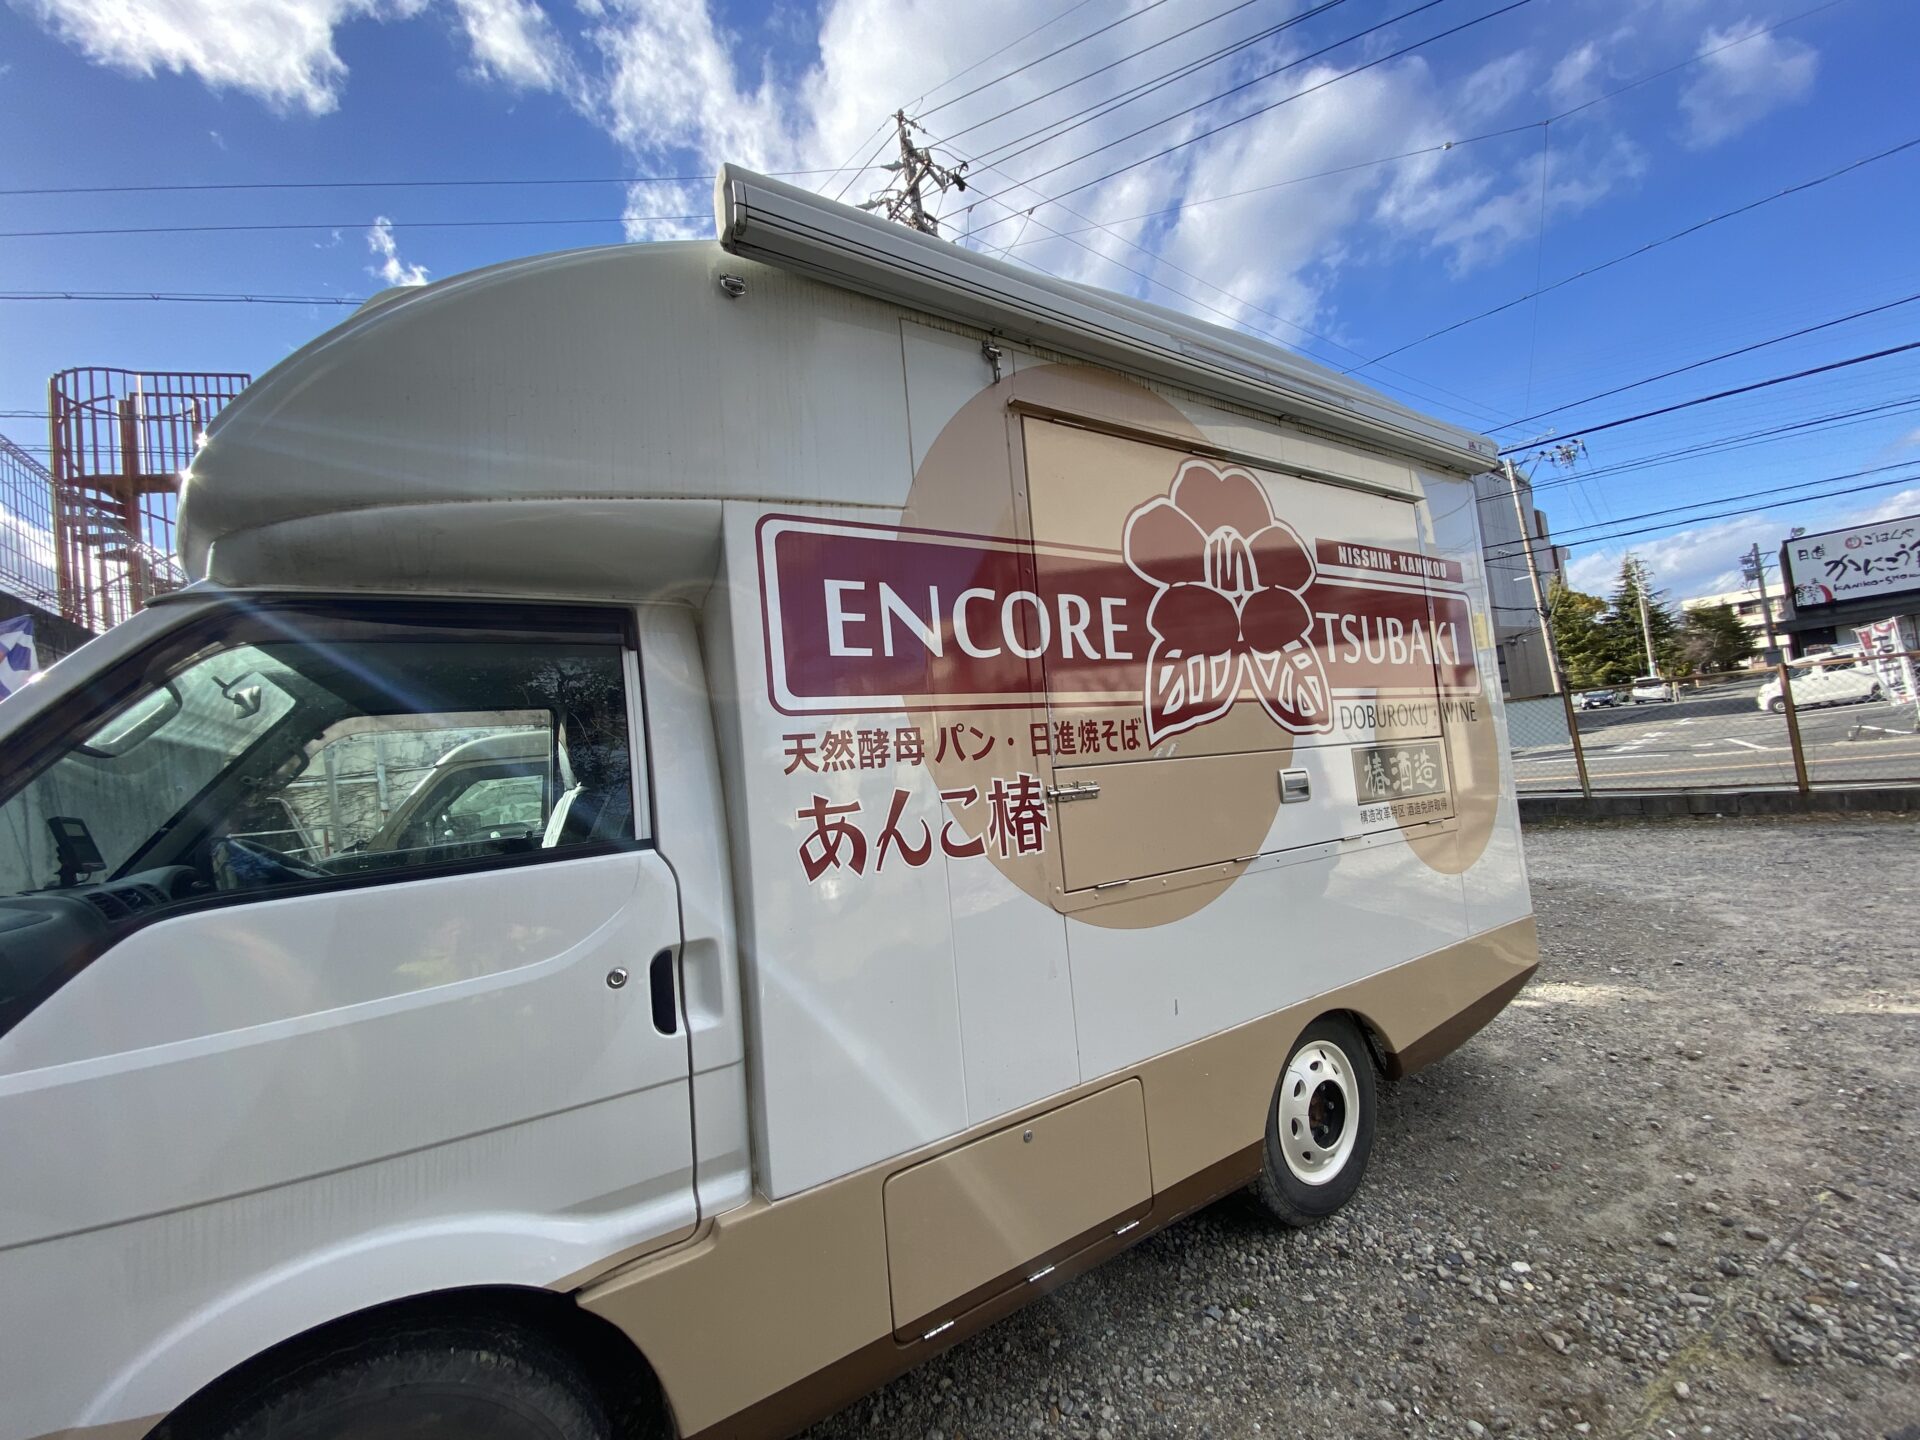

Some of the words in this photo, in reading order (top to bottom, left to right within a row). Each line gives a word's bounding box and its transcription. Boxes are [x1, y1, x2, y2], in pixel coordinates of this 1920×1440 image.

[824, 579, 1133, 659] ENCORE
[1316, 612, 1460, 665] TSUBAKI
[1340, 702, 1428, 730] DOBUROKU
[1441, 701, 1477, 723] WINE
[782, 727, 926, 776] 天然酵母
[1364, 748, 1437, 797] 椿酒造
[797, 772, 1051, 884] あんこ椿
